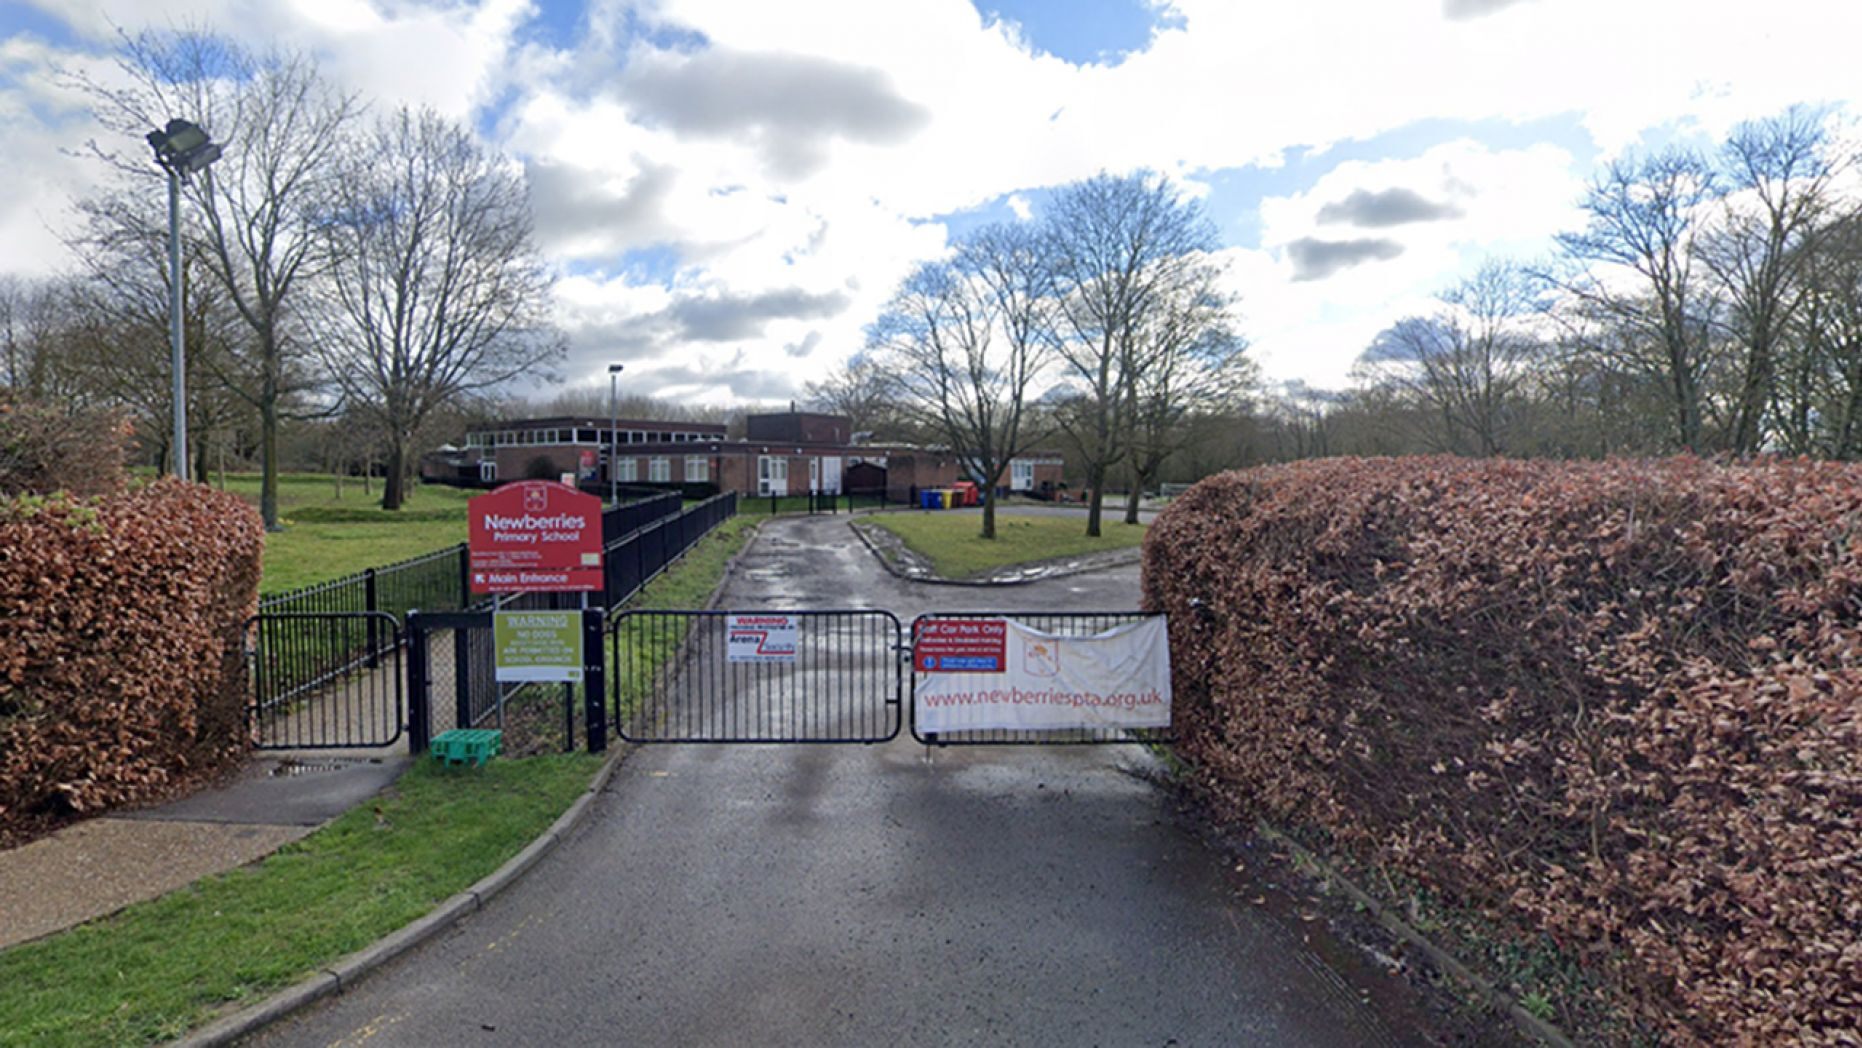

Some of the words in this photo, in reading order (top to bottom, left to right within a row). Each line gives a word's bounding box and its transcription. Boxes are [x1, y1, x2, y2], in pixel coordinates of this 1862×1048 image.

[484, 513, 585, 530] Newberries
[494, 531, 537, 544] Primary
[541, 530, 579, 542] School
[488, 573, 517, 583] Main
[520, 572, 568, 583] Entrance
[506, 614, 568, 627] WARNING
[736, 616, 788, 625] WARNING
[517, 630, 530, 639] NO
[532, 630, 557, 639] DOGS
[940, 624, 957, 634] Car
[959, 624, 979, 634] Park
[982, 624, 1003, 635] Only
[729, 633, 760, 643] Arena
